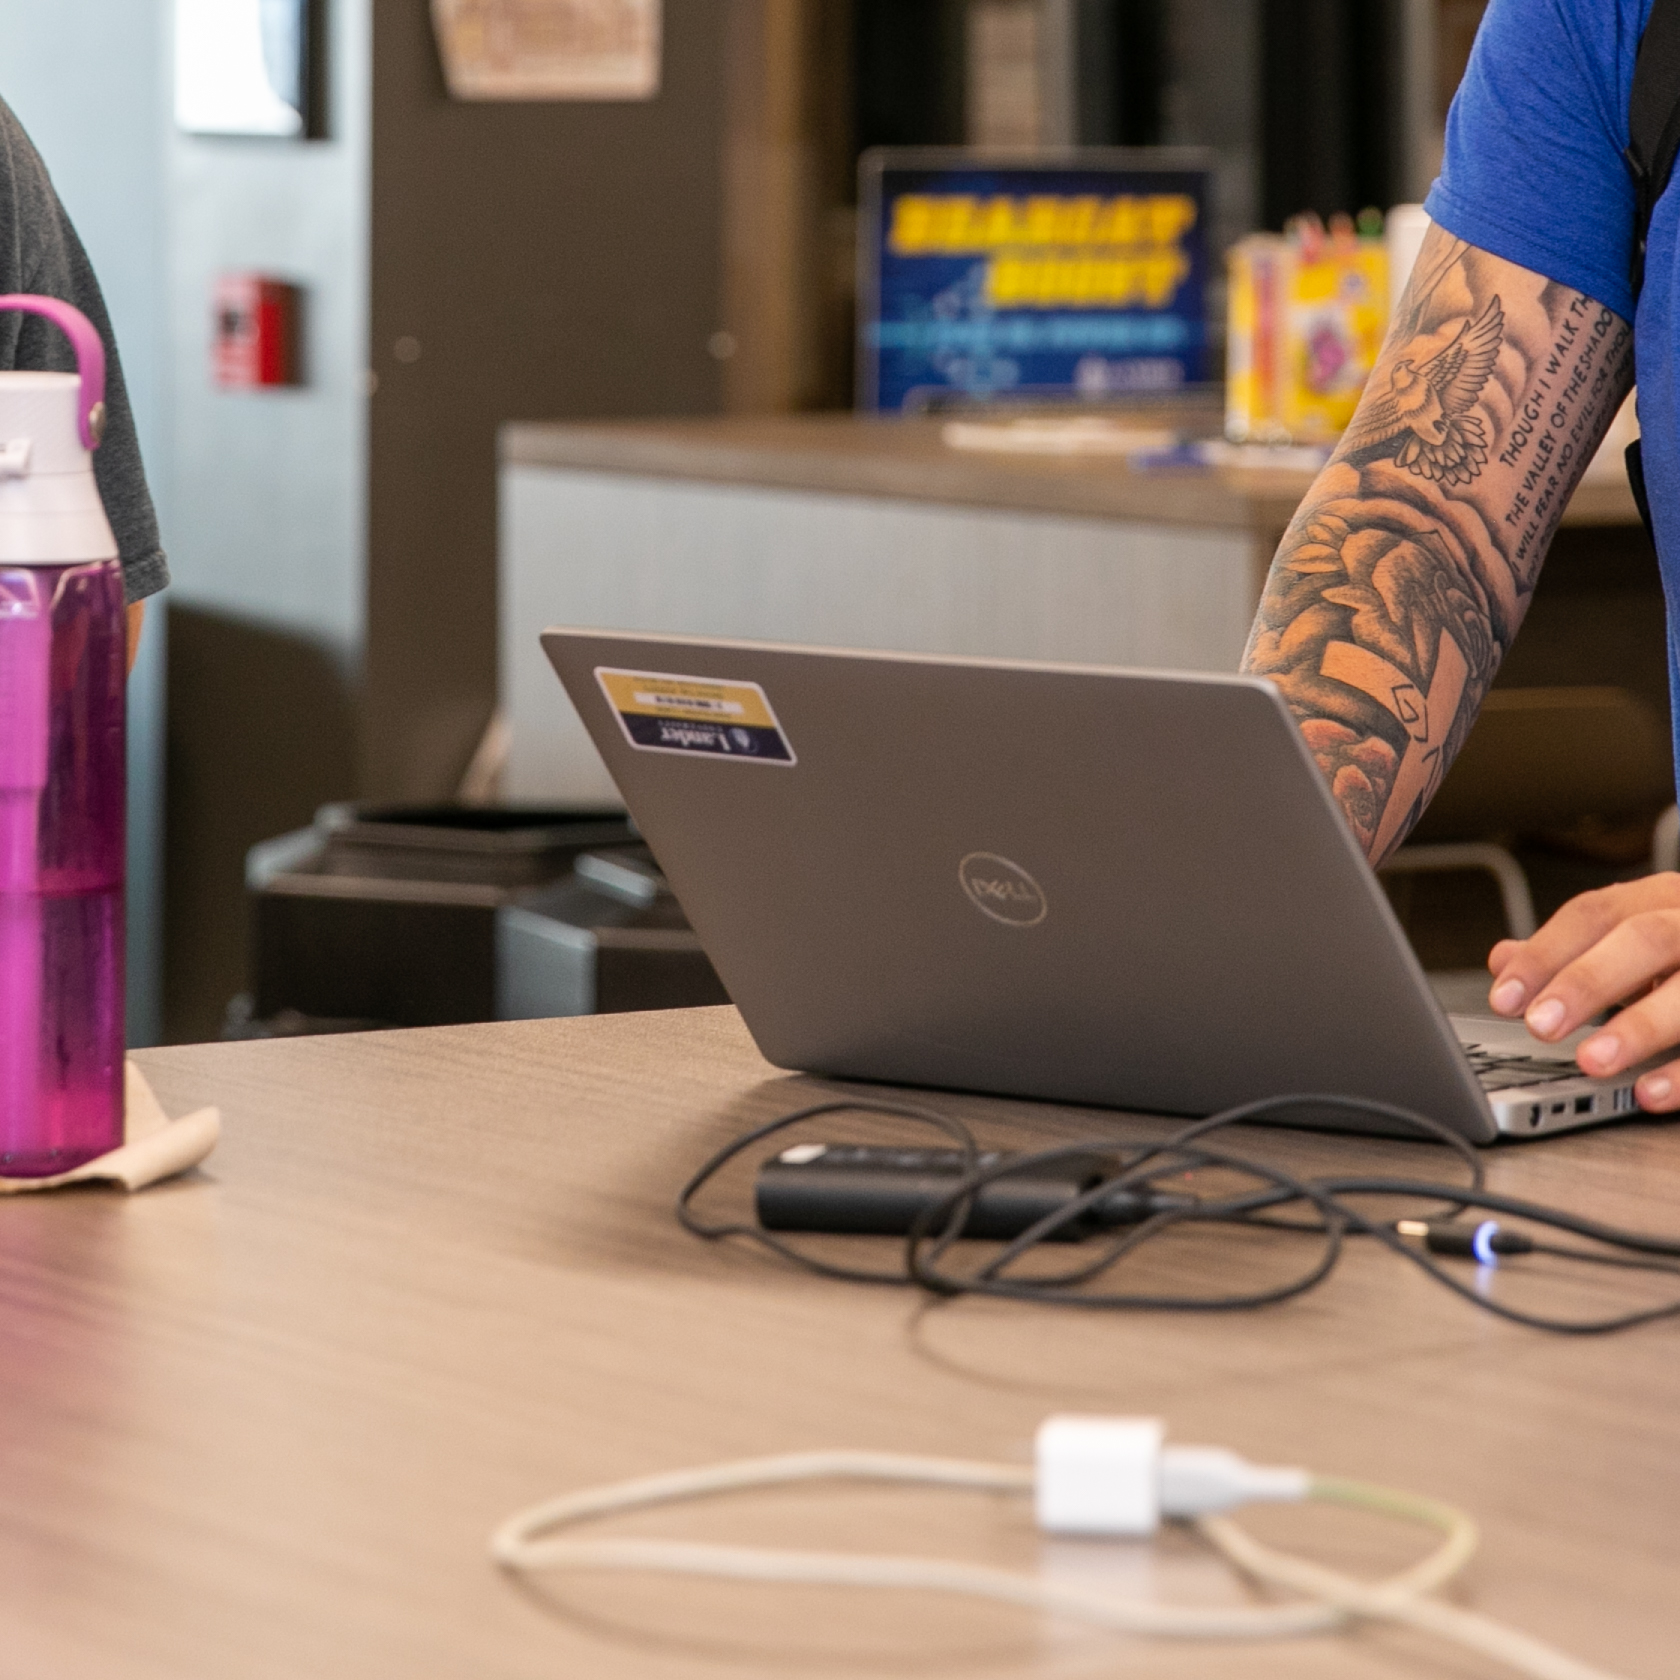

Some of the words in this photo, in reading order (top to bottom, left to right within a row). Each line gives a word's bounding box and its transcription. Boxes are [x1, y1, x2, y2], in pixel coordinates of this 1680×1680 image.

[1498, 389, 1546, 468] THOUGH
[1538, 378, 1552, 390] I
[1545, 318, 1580, 375] WALK
[1505, 492, 1530, 528] THE
[1522, 428, 1557, 492] VALLEY
[1550, 401, 1569, 429] OF
[1516, 521, 1540, 561] WILL
[1534, 475, 1560, 520] FEAR
[1556, 443, 1574, 475] NO
